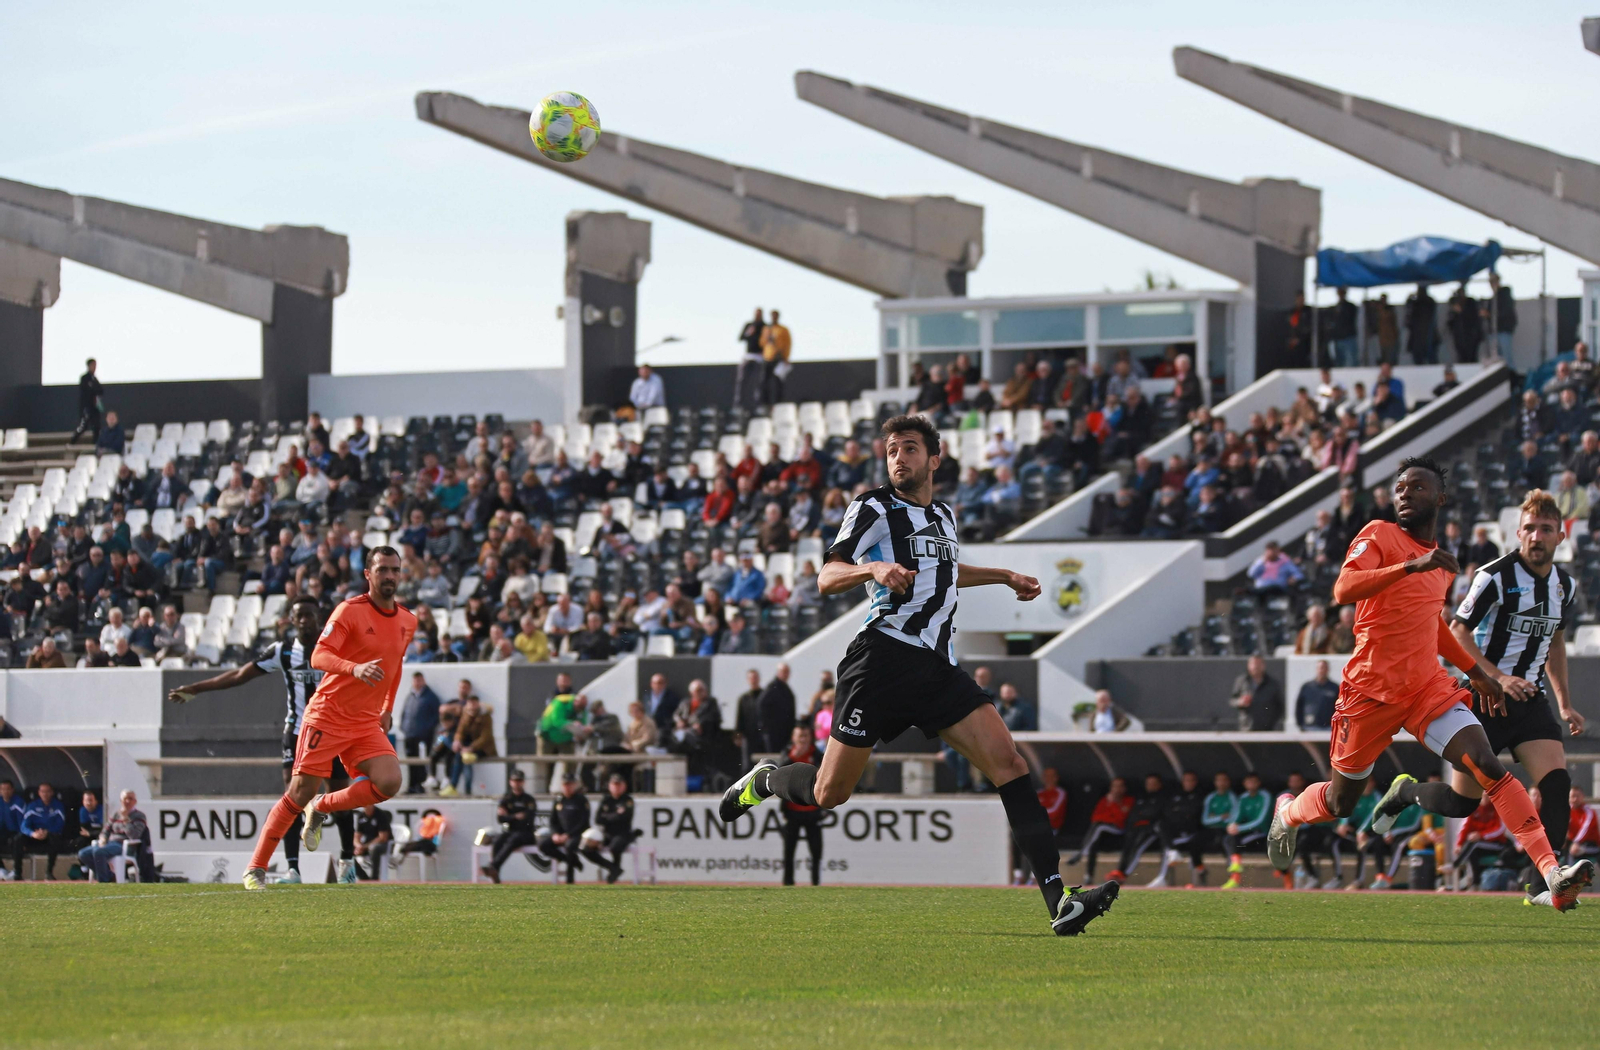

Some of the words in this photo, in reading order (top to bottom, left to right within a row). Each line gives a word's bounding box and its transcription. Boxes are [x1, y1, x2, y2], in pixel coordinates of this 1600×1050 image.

[910, 537, 959, 562] LOTU
[848, 707, 863, 727] 5
[838, 723, 866, 736] LEGEA
[651, 807, 954, 842] PANDAPORTS
[1045, 873, 1061, 885] LEG
